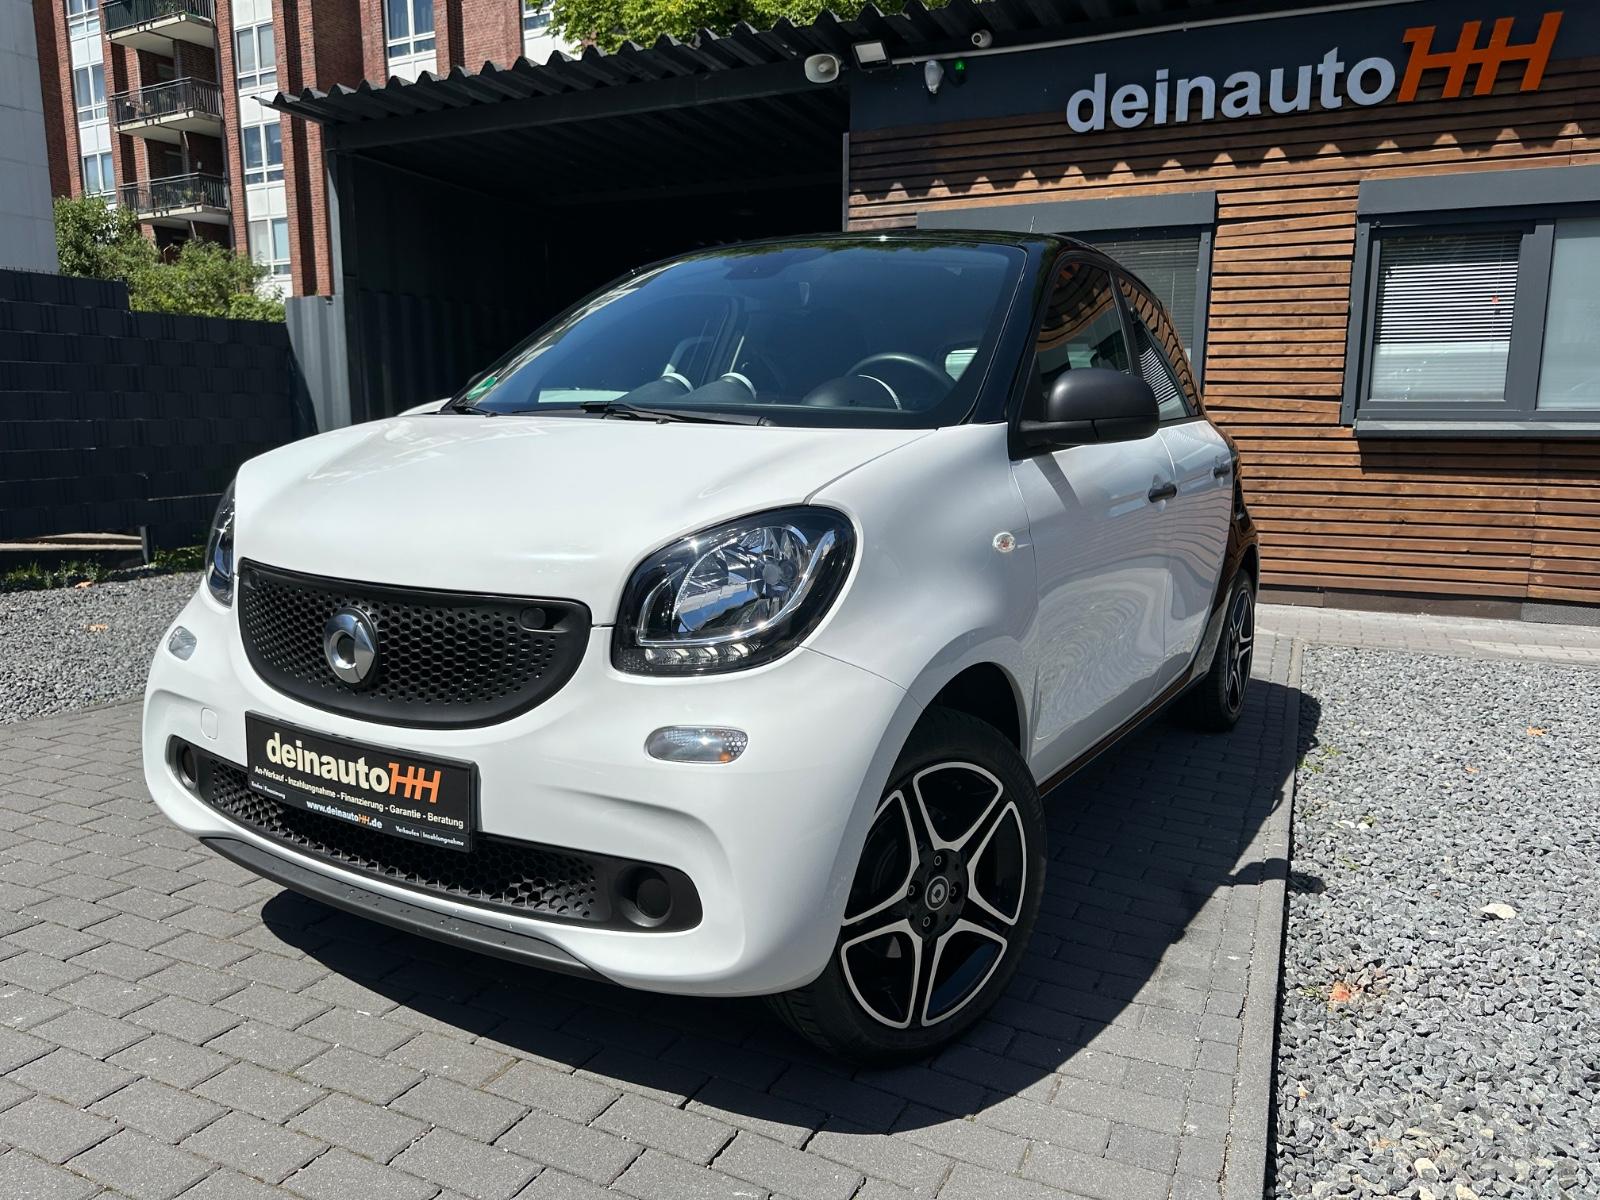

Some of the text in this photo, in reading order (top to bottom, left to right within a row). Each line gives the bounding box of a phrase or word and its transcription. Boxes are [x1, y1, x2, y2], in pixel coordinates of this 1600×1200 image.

[287, 775, 336, 798] Inzahlungnahme
[340, 791, 384, 813] Finanzierung
[389, 804, 421, 819] Garantie
[427, 812, 464, 829] Beratung
